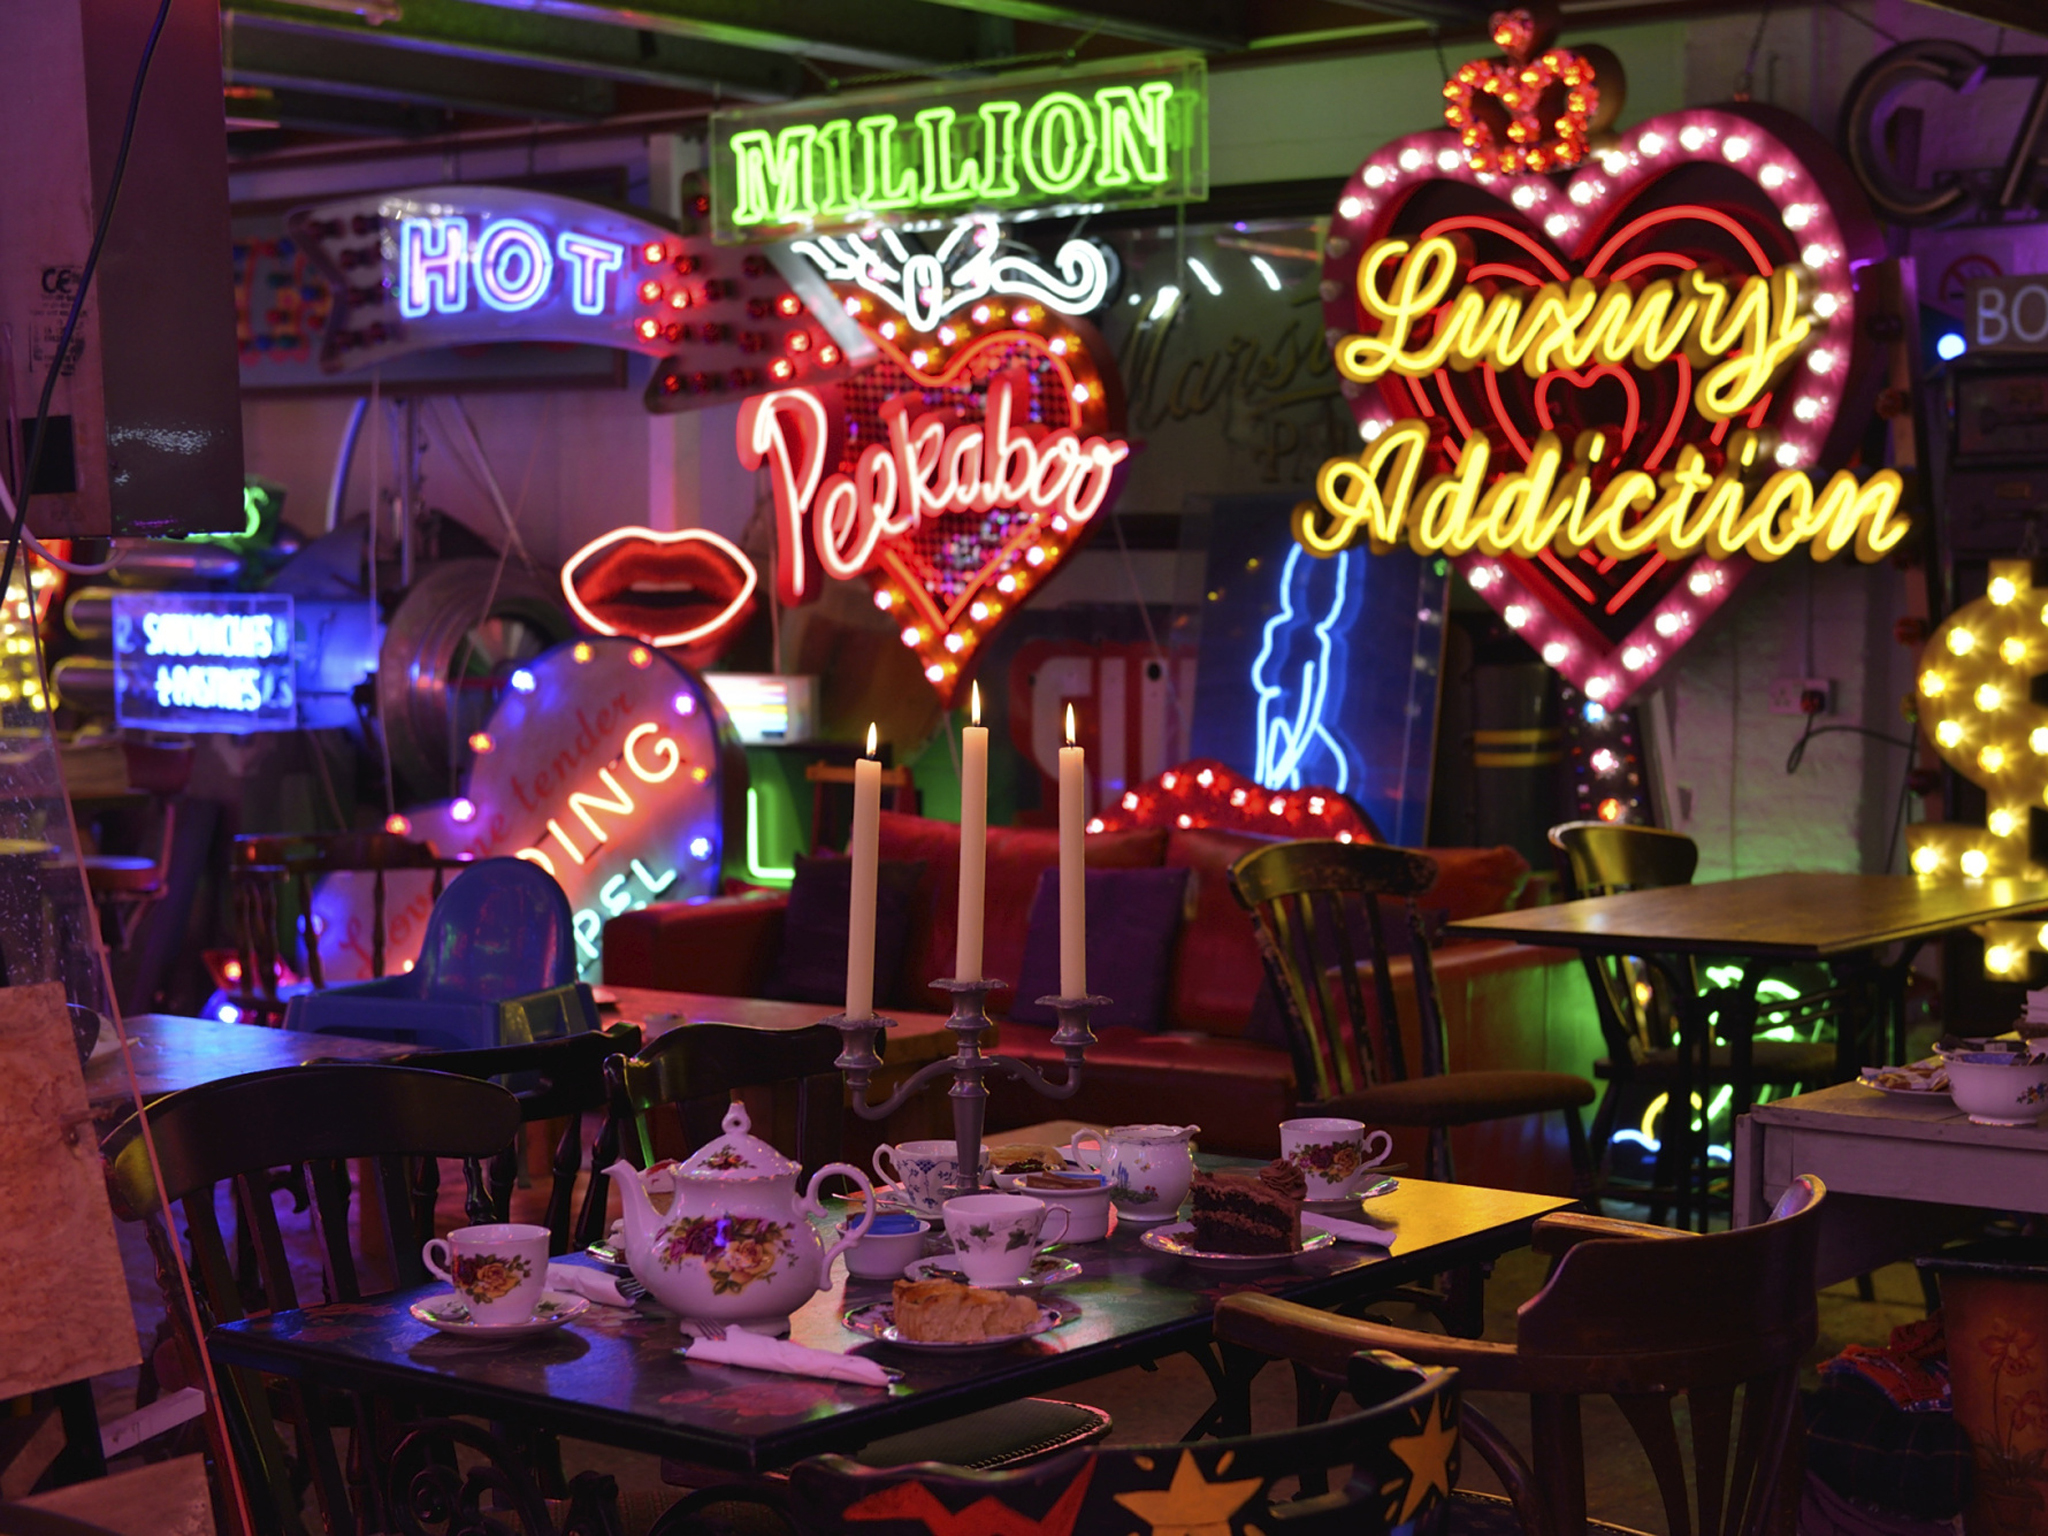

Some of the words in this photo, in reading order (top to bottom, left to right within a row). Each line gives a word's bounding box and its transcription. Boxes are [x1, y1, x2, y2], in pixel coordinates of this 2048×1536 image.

[730, 80, 1176, 226] MILLION
[41, 267, 72, 294] CE
[400, 216, 624, 319] HOT
[1335, 236, 1811, 421] Luxury
[737, 378, 1129, 606] Peekaboo
[1293, 419, 1910, 562] Addiction
[510, 692, 636, 813] tender
